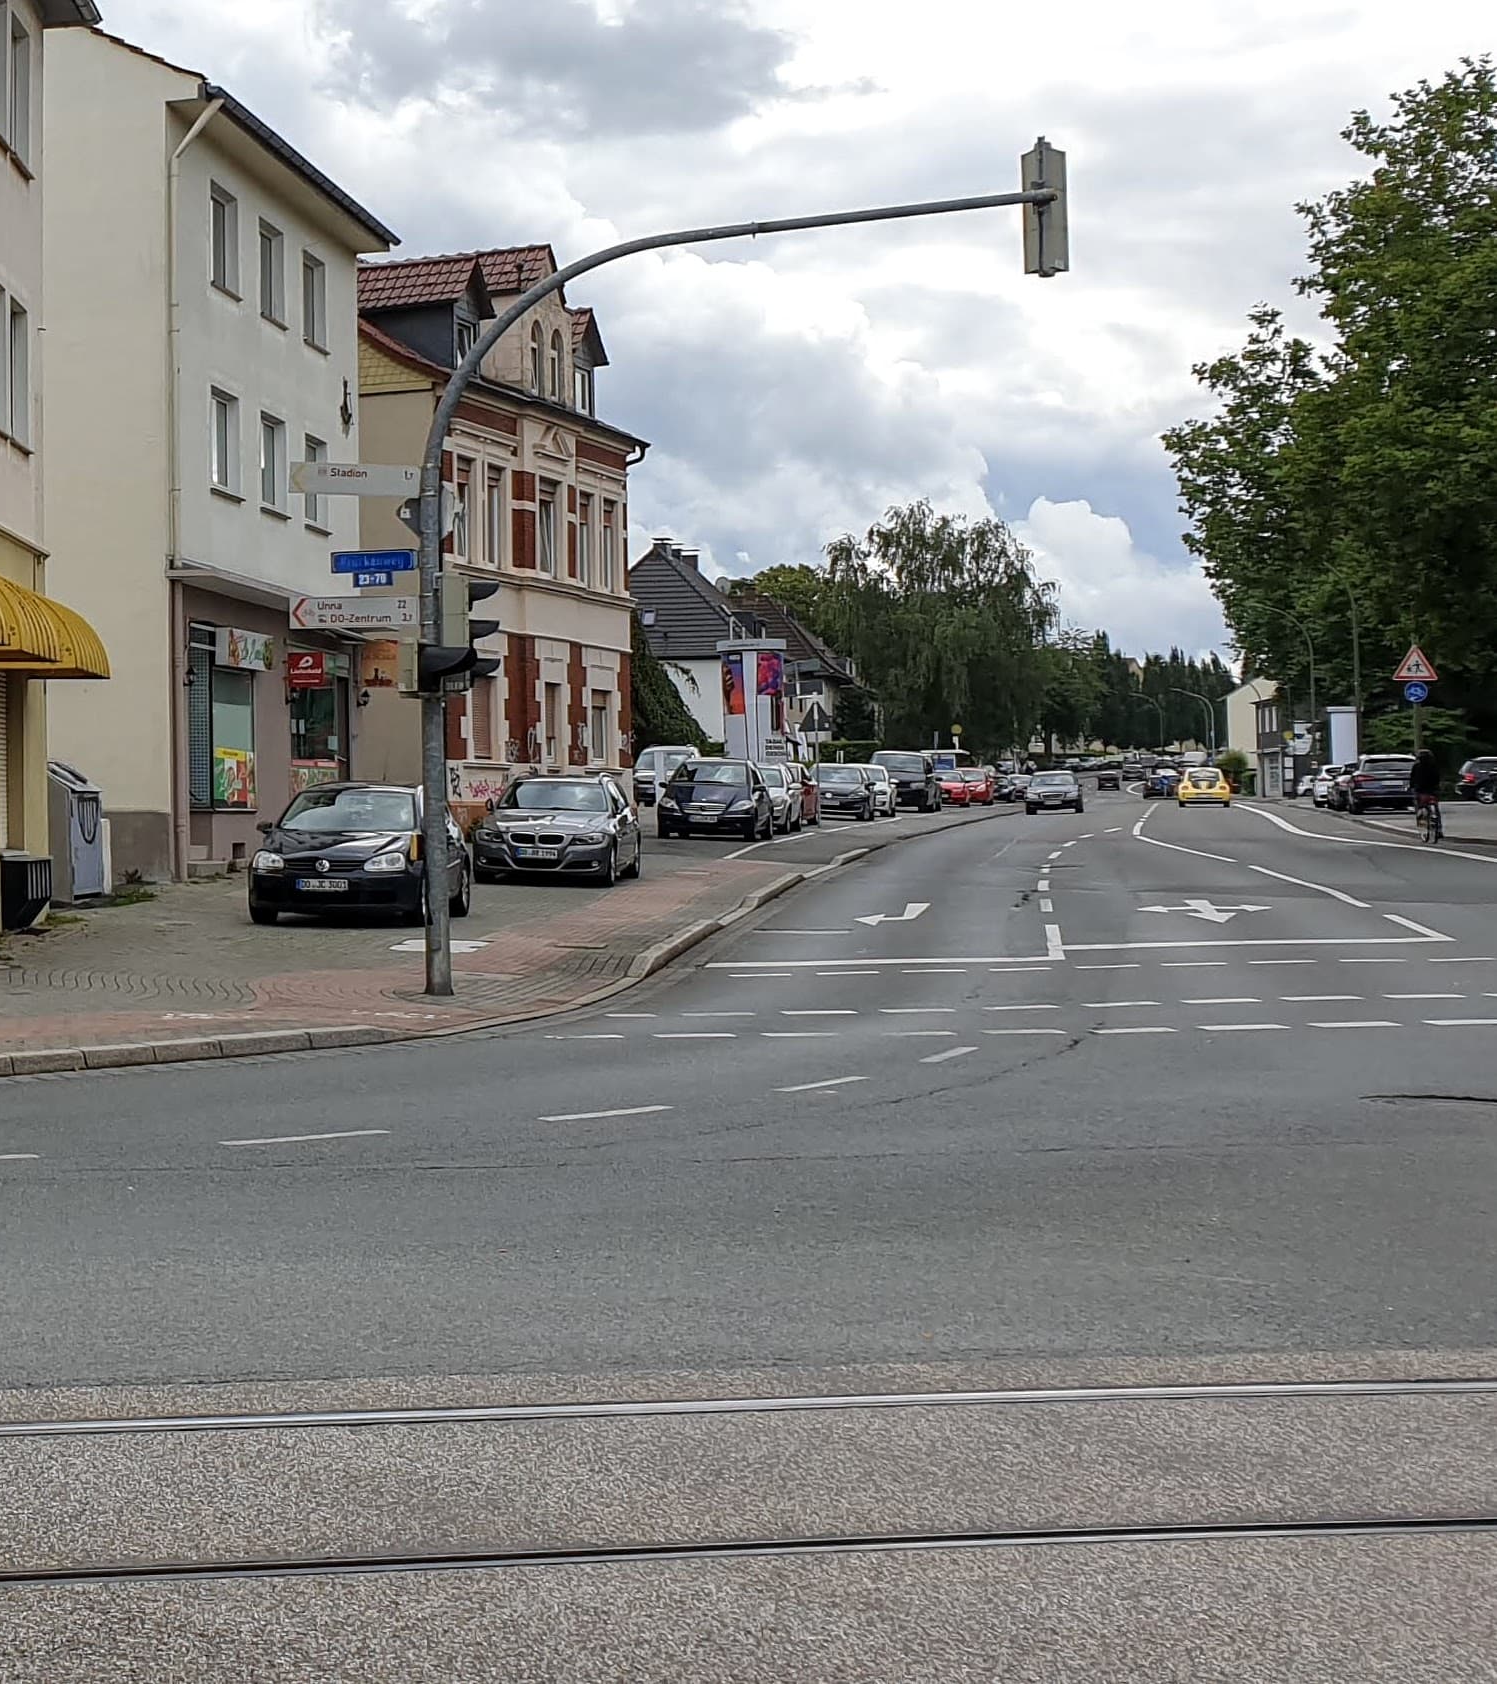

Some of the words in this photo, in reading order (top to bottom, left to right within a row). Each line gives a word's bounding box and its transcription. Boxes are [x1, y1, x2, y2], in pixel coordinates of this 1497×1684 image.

[330, 467, 368, 478] Stadion
[317, 600, 343, 610] Unna
[397, 600, 407, 609] 22
[330, 614, 392, 623] DO-Zentrum
